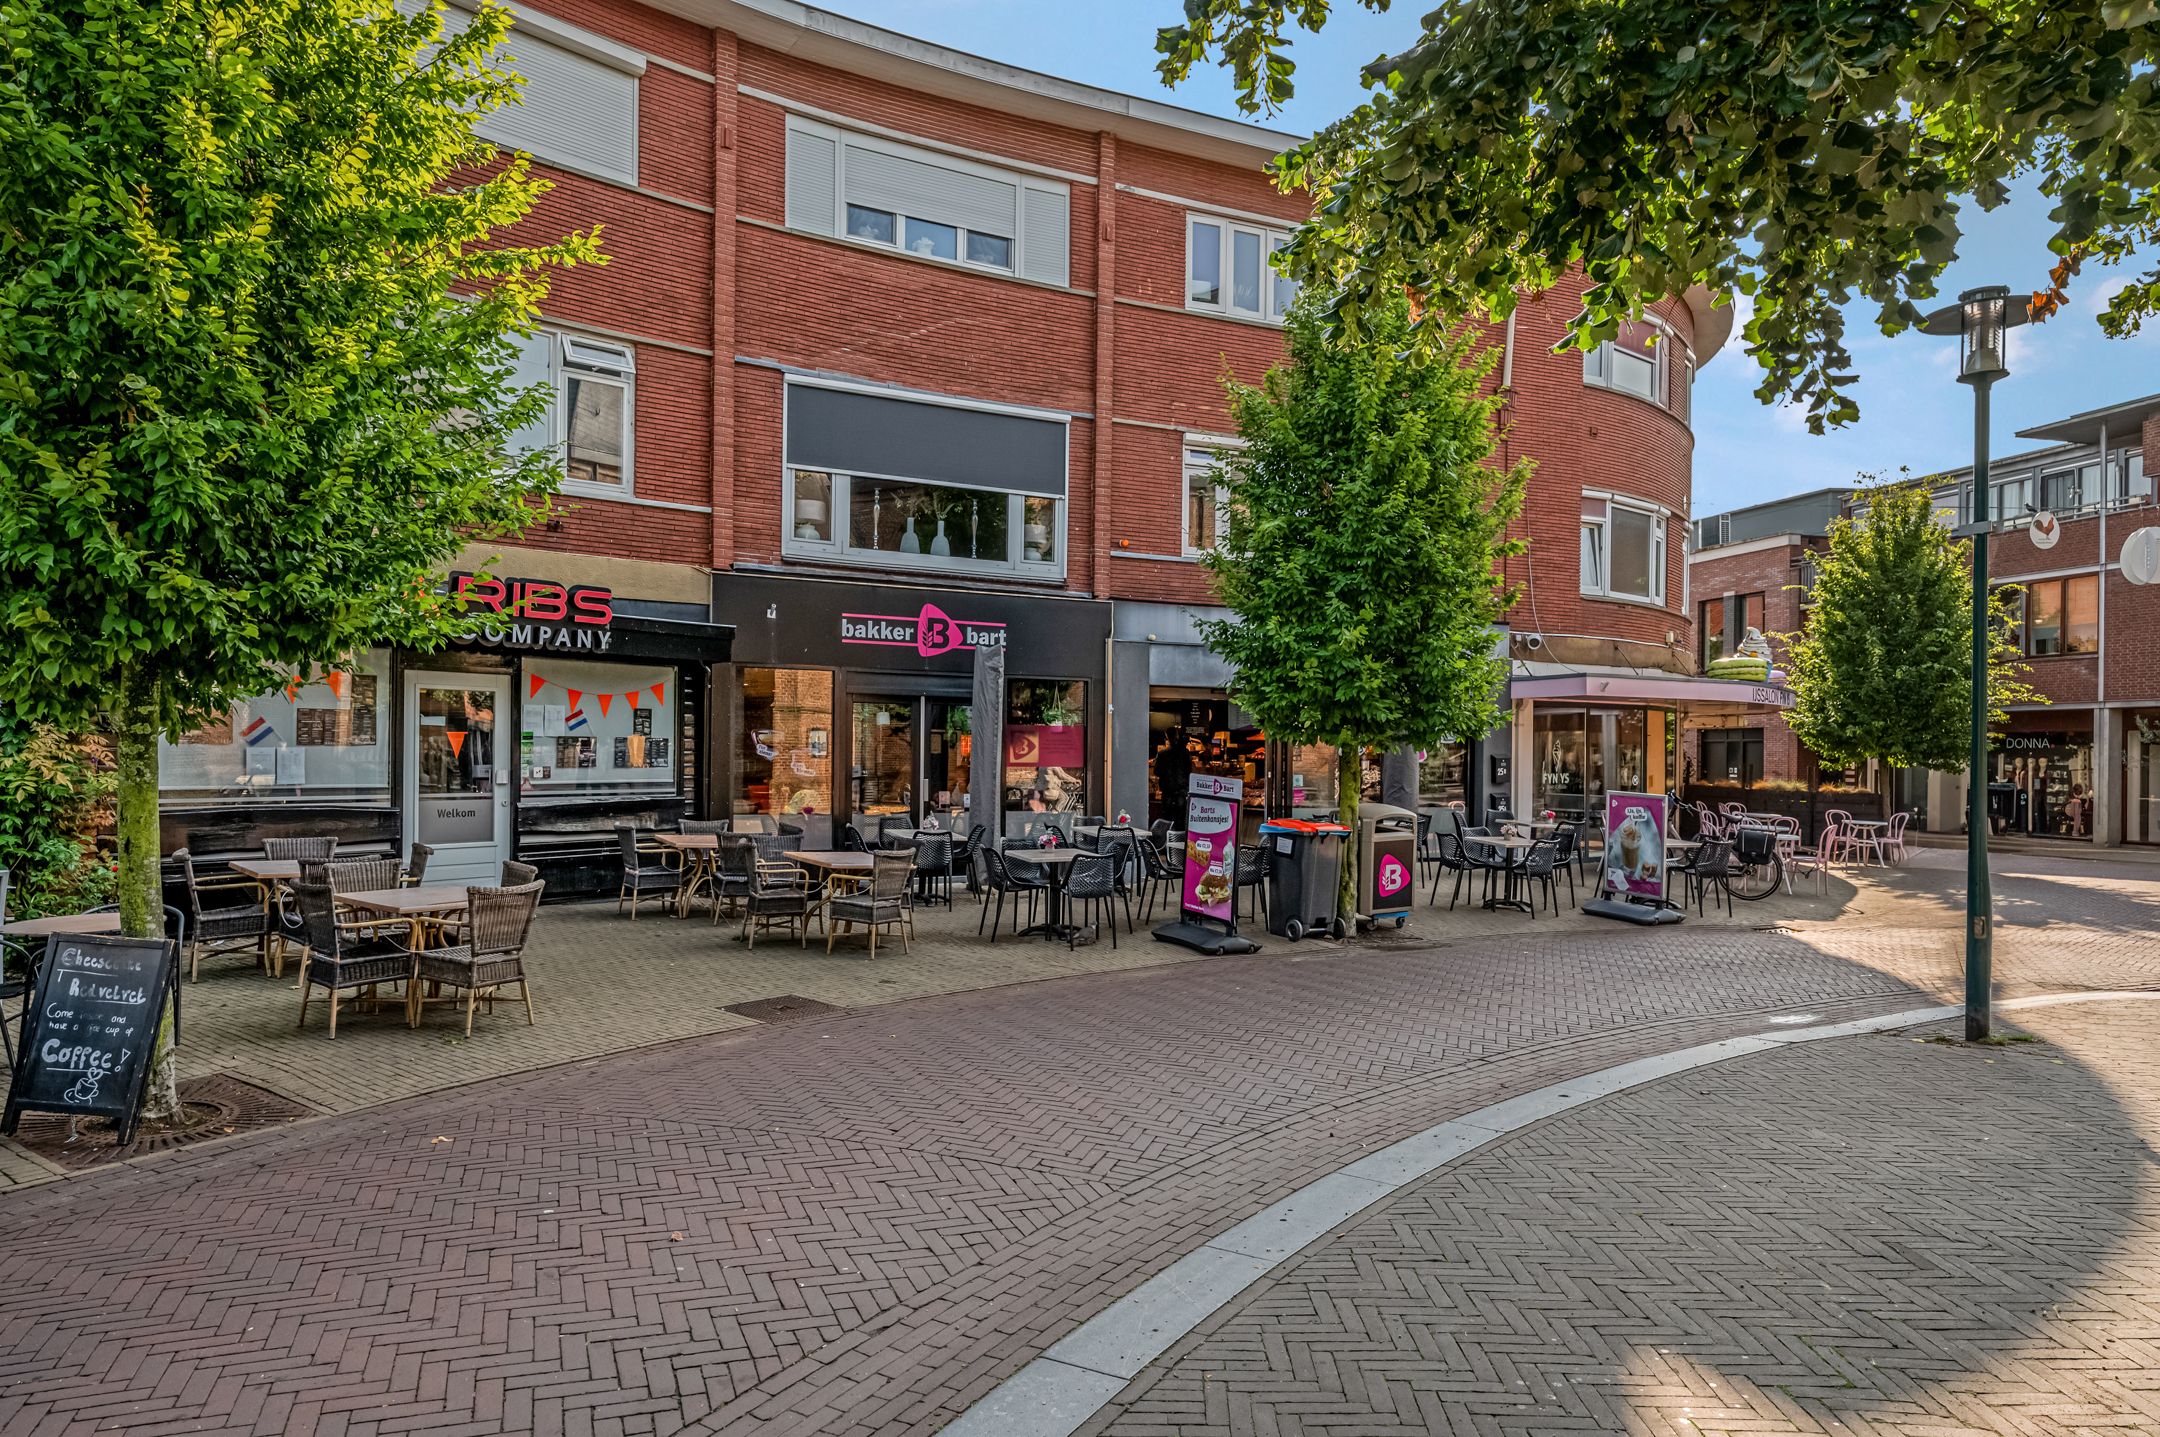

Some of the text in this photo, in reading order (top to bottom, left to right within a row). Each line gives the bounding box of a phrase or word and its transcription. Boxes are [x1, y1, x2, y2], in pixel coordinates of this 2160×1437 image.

[457, 575, 613, 625] RIBS
[841, 618, 914, 641] bakker
[966, 626, 1007, 646] bart
[1196, 781, 1213, 790] Bakker
[437, 808, 476, 818] Welkom
[1200, 806, 1215, 814] Barts
[1384, 864, 1402, 891] B
[46, 1002, 74, 1018] Come
[111, 1015, 127, 1024] and
[49, 1020, 68, 1030] have
[105, 1026, 120, 1037] cup
[125, 1027, 134, 1037] of
